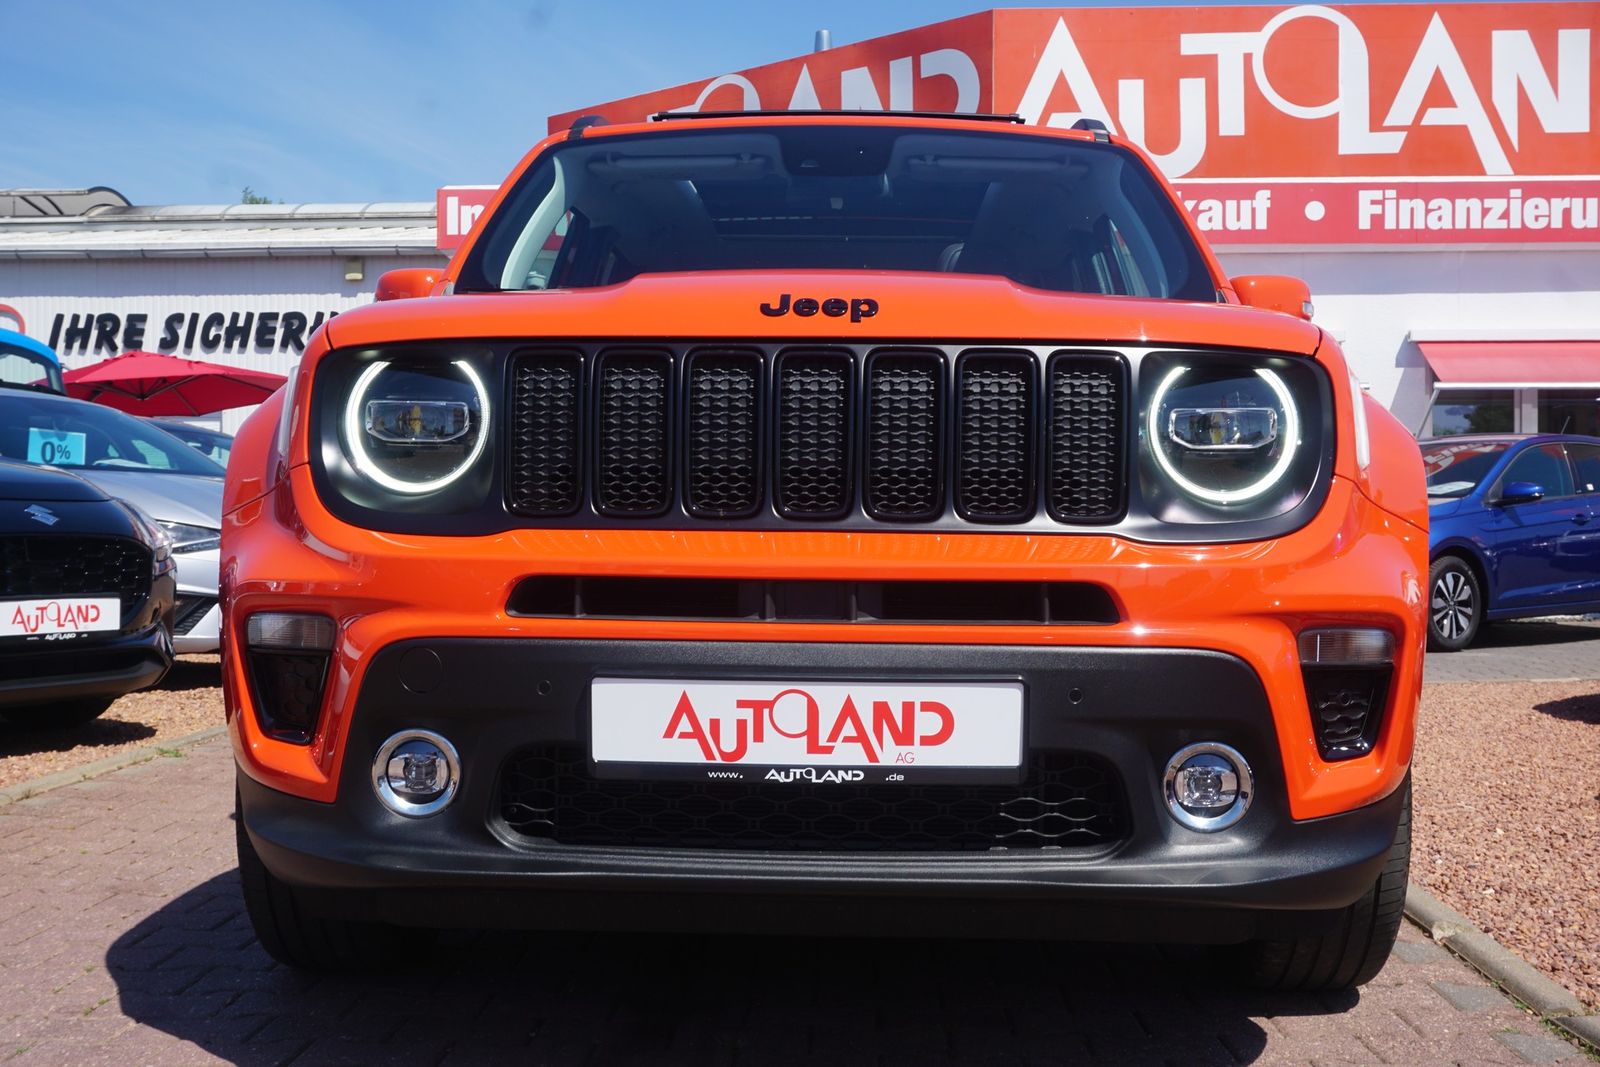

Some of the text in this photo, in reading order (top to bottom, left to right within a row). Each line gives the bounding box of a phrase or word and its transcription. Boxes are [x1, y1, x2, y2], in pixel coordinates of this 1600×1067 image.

[1358, 189, 1598, 230] Finanzieru
[760, 294, 879, 323] Jeep
[48, 313, 148, 353] IHRE
[41, 441, 71, 464] 0%
[12, 601, 100, 632] AUTOLAND
[662, 688, 955, 763] AUTOLAND
[895, 751, 915, 764] AG
[765, 767, 864, 783] AUTOLAND
